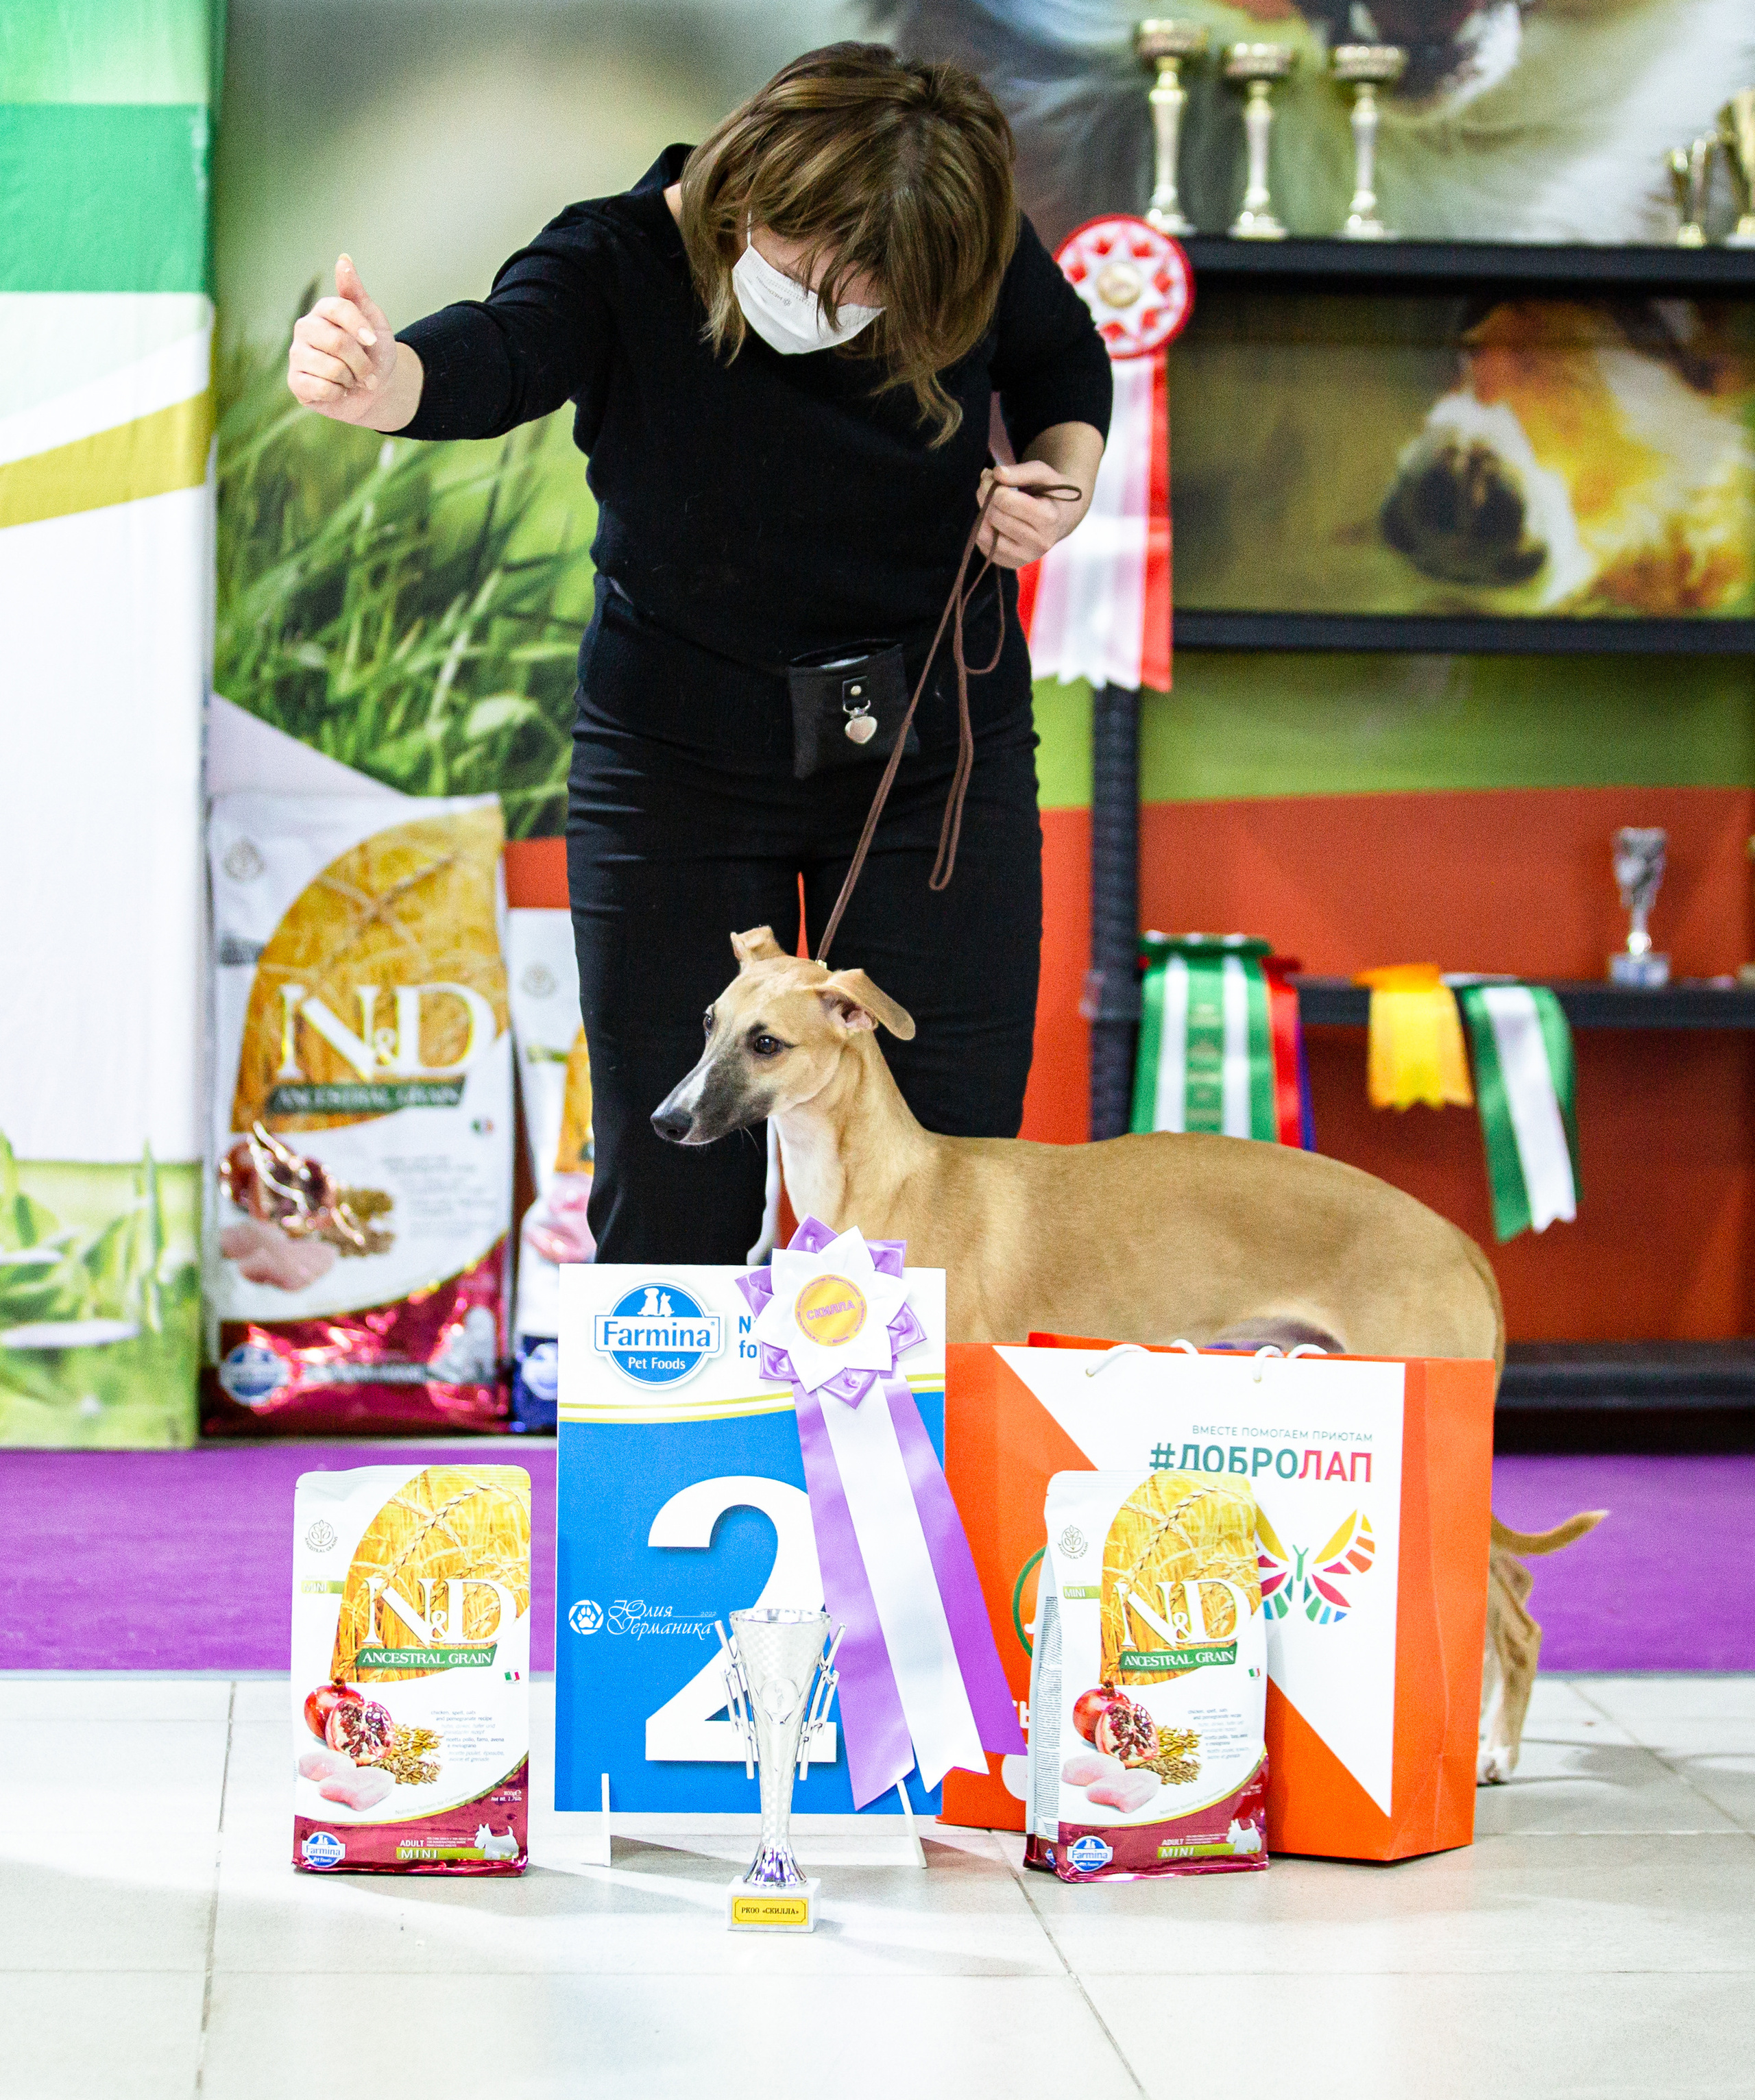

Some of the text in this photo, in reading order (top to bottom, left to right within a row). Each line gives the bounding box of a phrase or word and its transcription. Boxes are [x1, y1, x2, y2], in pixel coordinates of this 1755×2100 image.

[277, 983, 496, 1081] N&D
[807, 1299, 856, 1320] СКИЛЛА
[603, 1321, 711, 1347] Farmina
[628, 1356, 686, 1369] Pet Foods
[1192, 1425, 1372, 1442] ВМЕСТЕ ПОМОГАЕМ ПРИЮТАМ
[1149, 1442, 1372, 1482] #ДОБРОЛАП
[304, 1582, 328, 1592] MINI
[1065, 1589, 1086, 1597] MINI
[361, 1578, 517, 1645] N&D
[645, 1475, 837, 1763] 2
[1113, 1578, 1252, 1647] N&D
[362, 1652, 492, 1665] ANCESTRAL GRAIN
[1124, 1650, 1233, 1666] ANCESTRAL GRAIN
[306, 1844, 341, 1855] Farmina
[401, 1849, 438, 1859] MINI
[1072, 1850, 1108, 1859] Farmina
[1161, 1847, 1194, 1858] MINI
